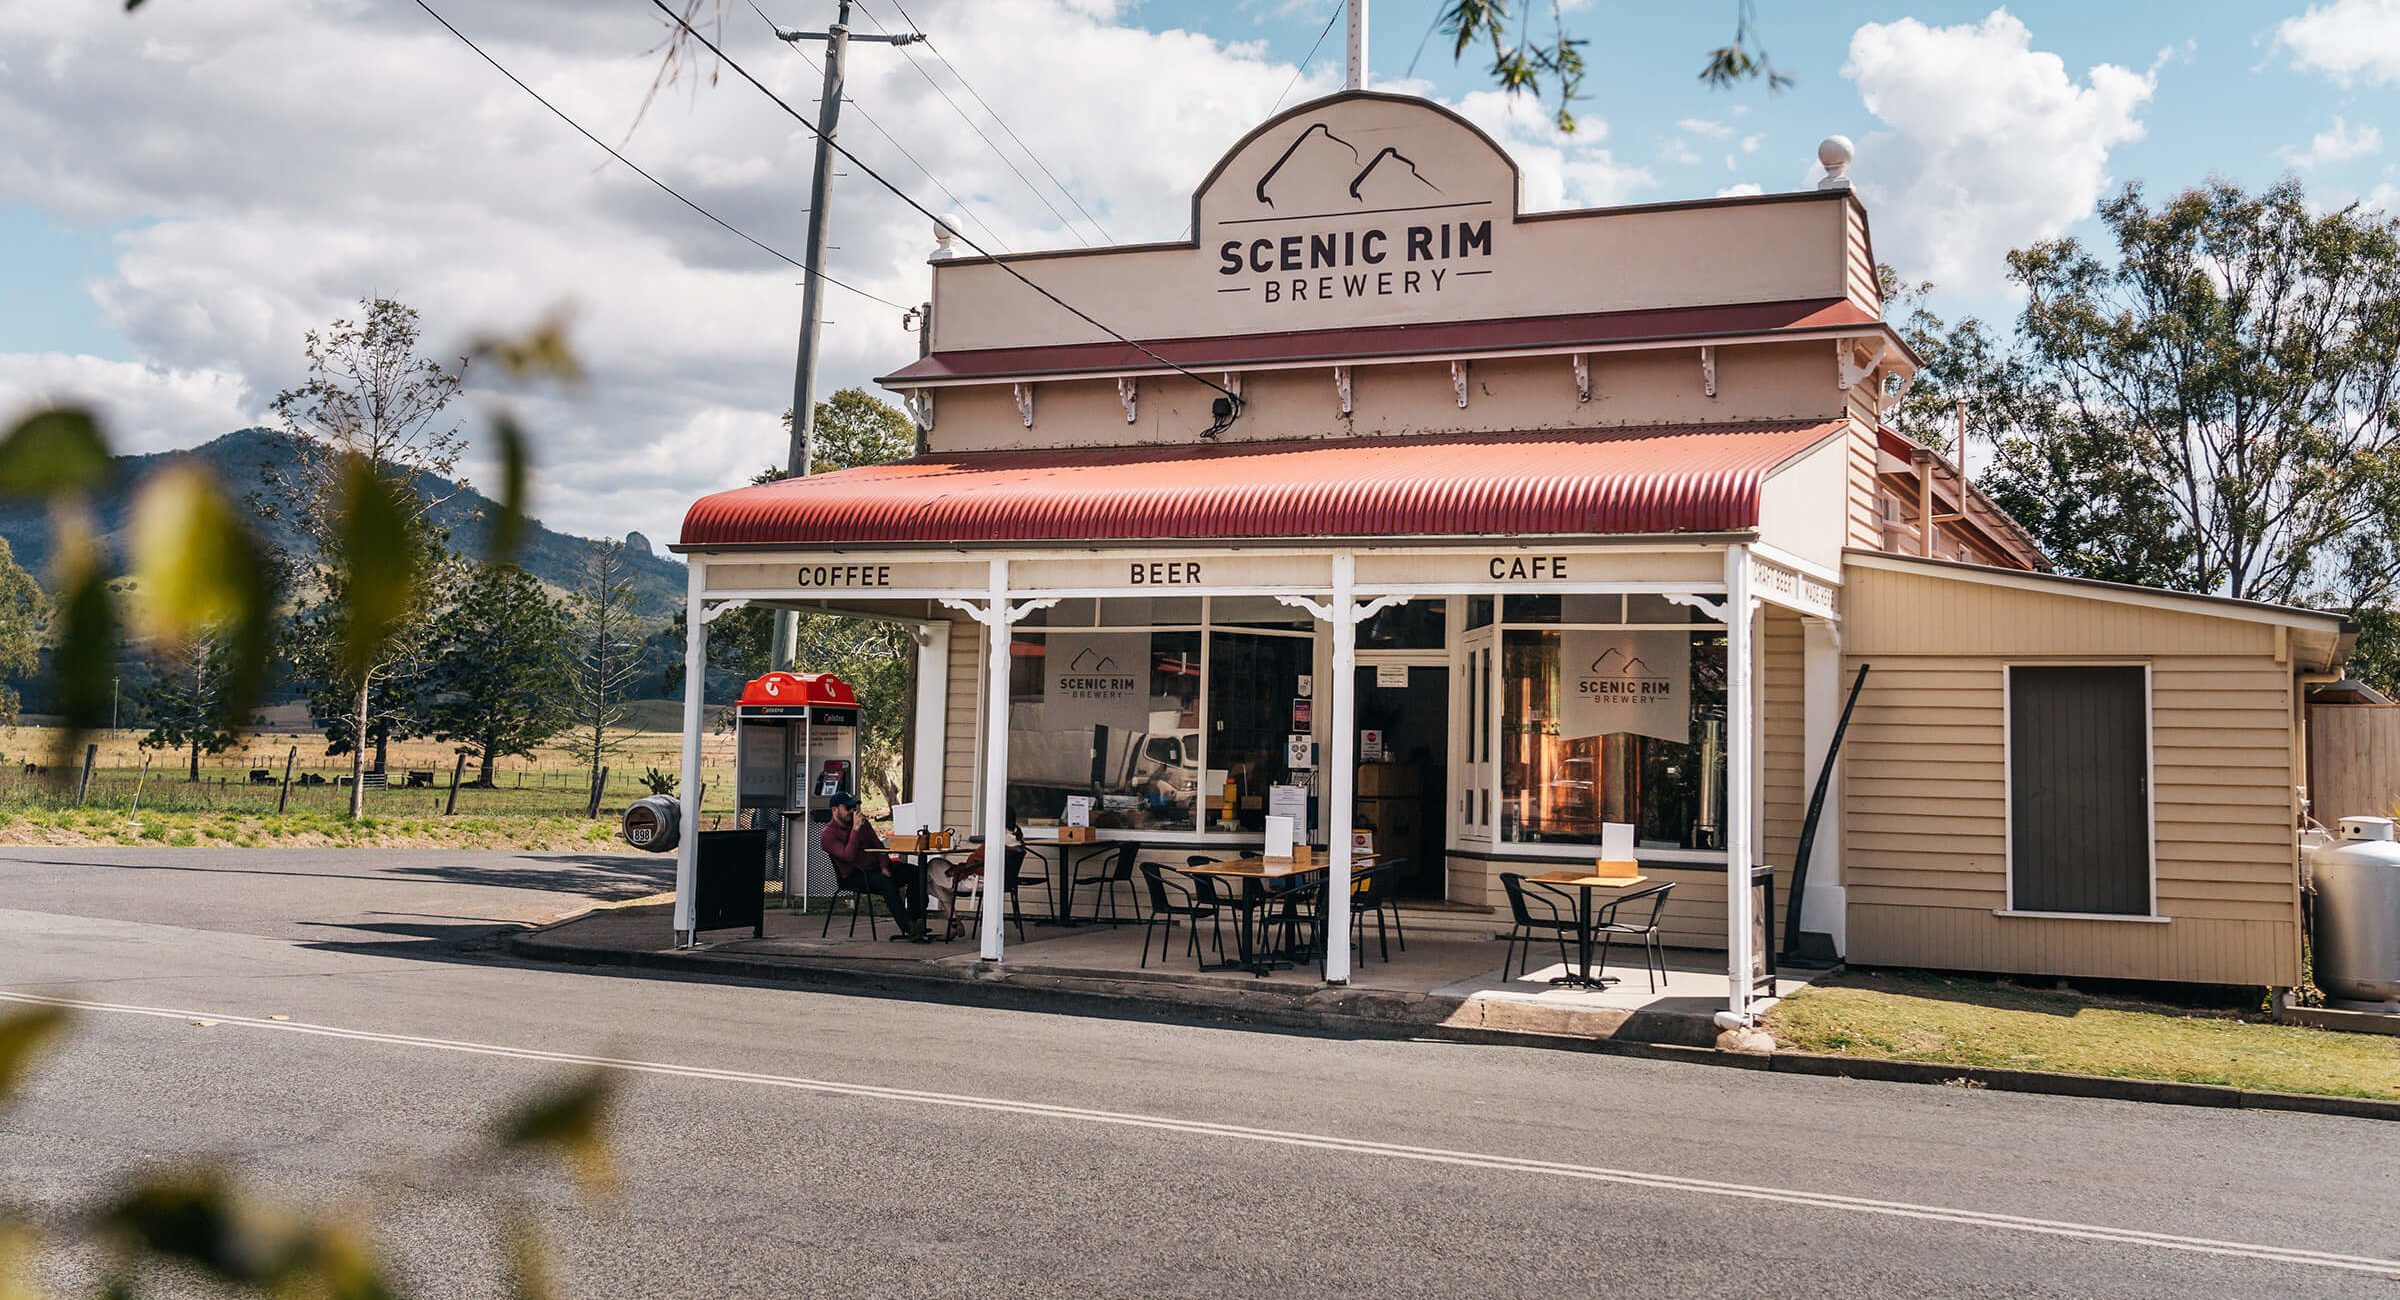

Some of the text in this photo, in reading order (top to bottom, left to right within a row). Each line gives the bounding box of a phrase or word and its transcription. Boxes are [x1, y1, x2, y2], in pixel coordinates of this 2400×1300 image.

[1219, 220, 1492, 275] SCENIC RIM
[1264, 268, 1446, 303] BREWERY
[798, 566, 890, 587] COFFEE
[1130, 562, 1201, 585] BEER
[1489, 556, 1568, 579] CAFE
[1060, 679, 1134, 690] SCENIC RIM
[1579, 681, 1670, 695] SCENIC RIM
[1594, 695, 1656, 704] BREWERY
[634, 829, 650, 840] 898
